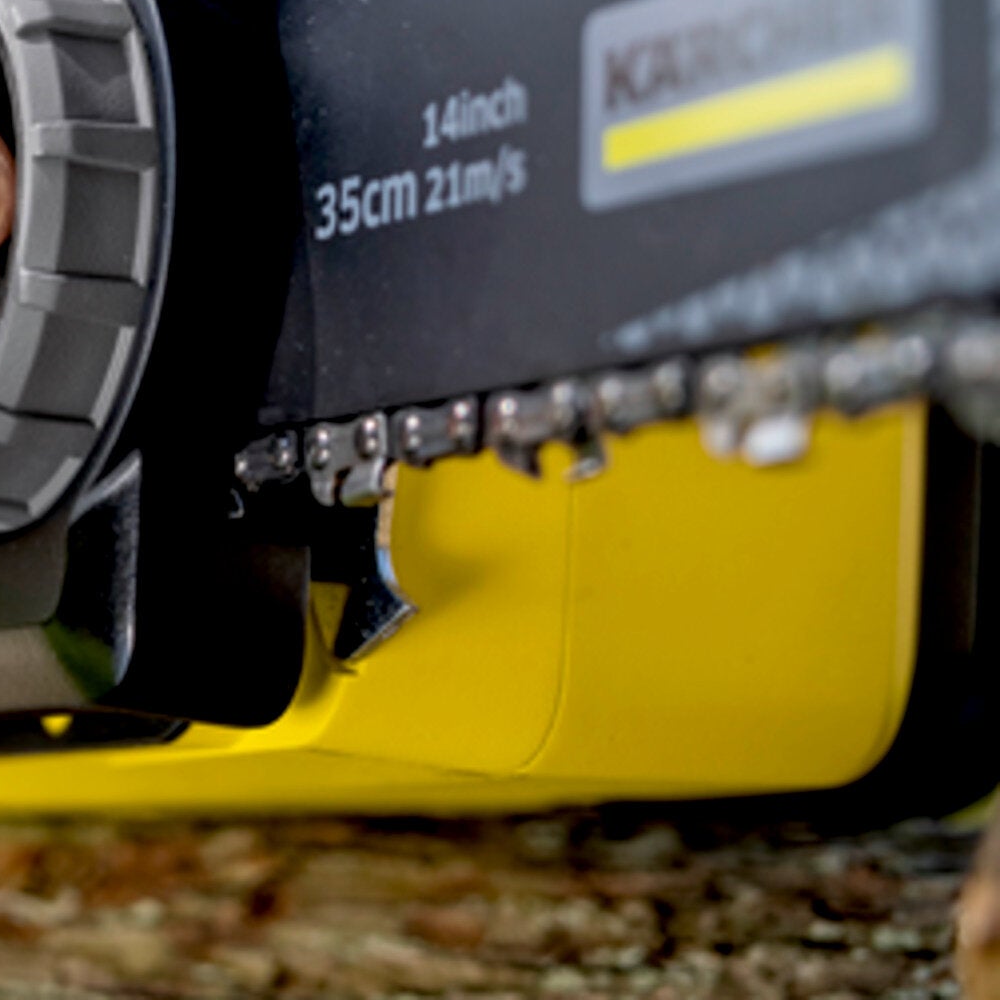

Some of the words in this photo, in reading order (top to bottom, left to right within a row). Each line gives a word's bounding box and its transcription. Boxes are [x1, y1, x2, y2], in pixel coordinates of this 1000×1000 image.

[422, 75, 527, 148] 14inch
[314, 171, 418, 240] 35cm
[424, 145, 527, 214] 21m/s
